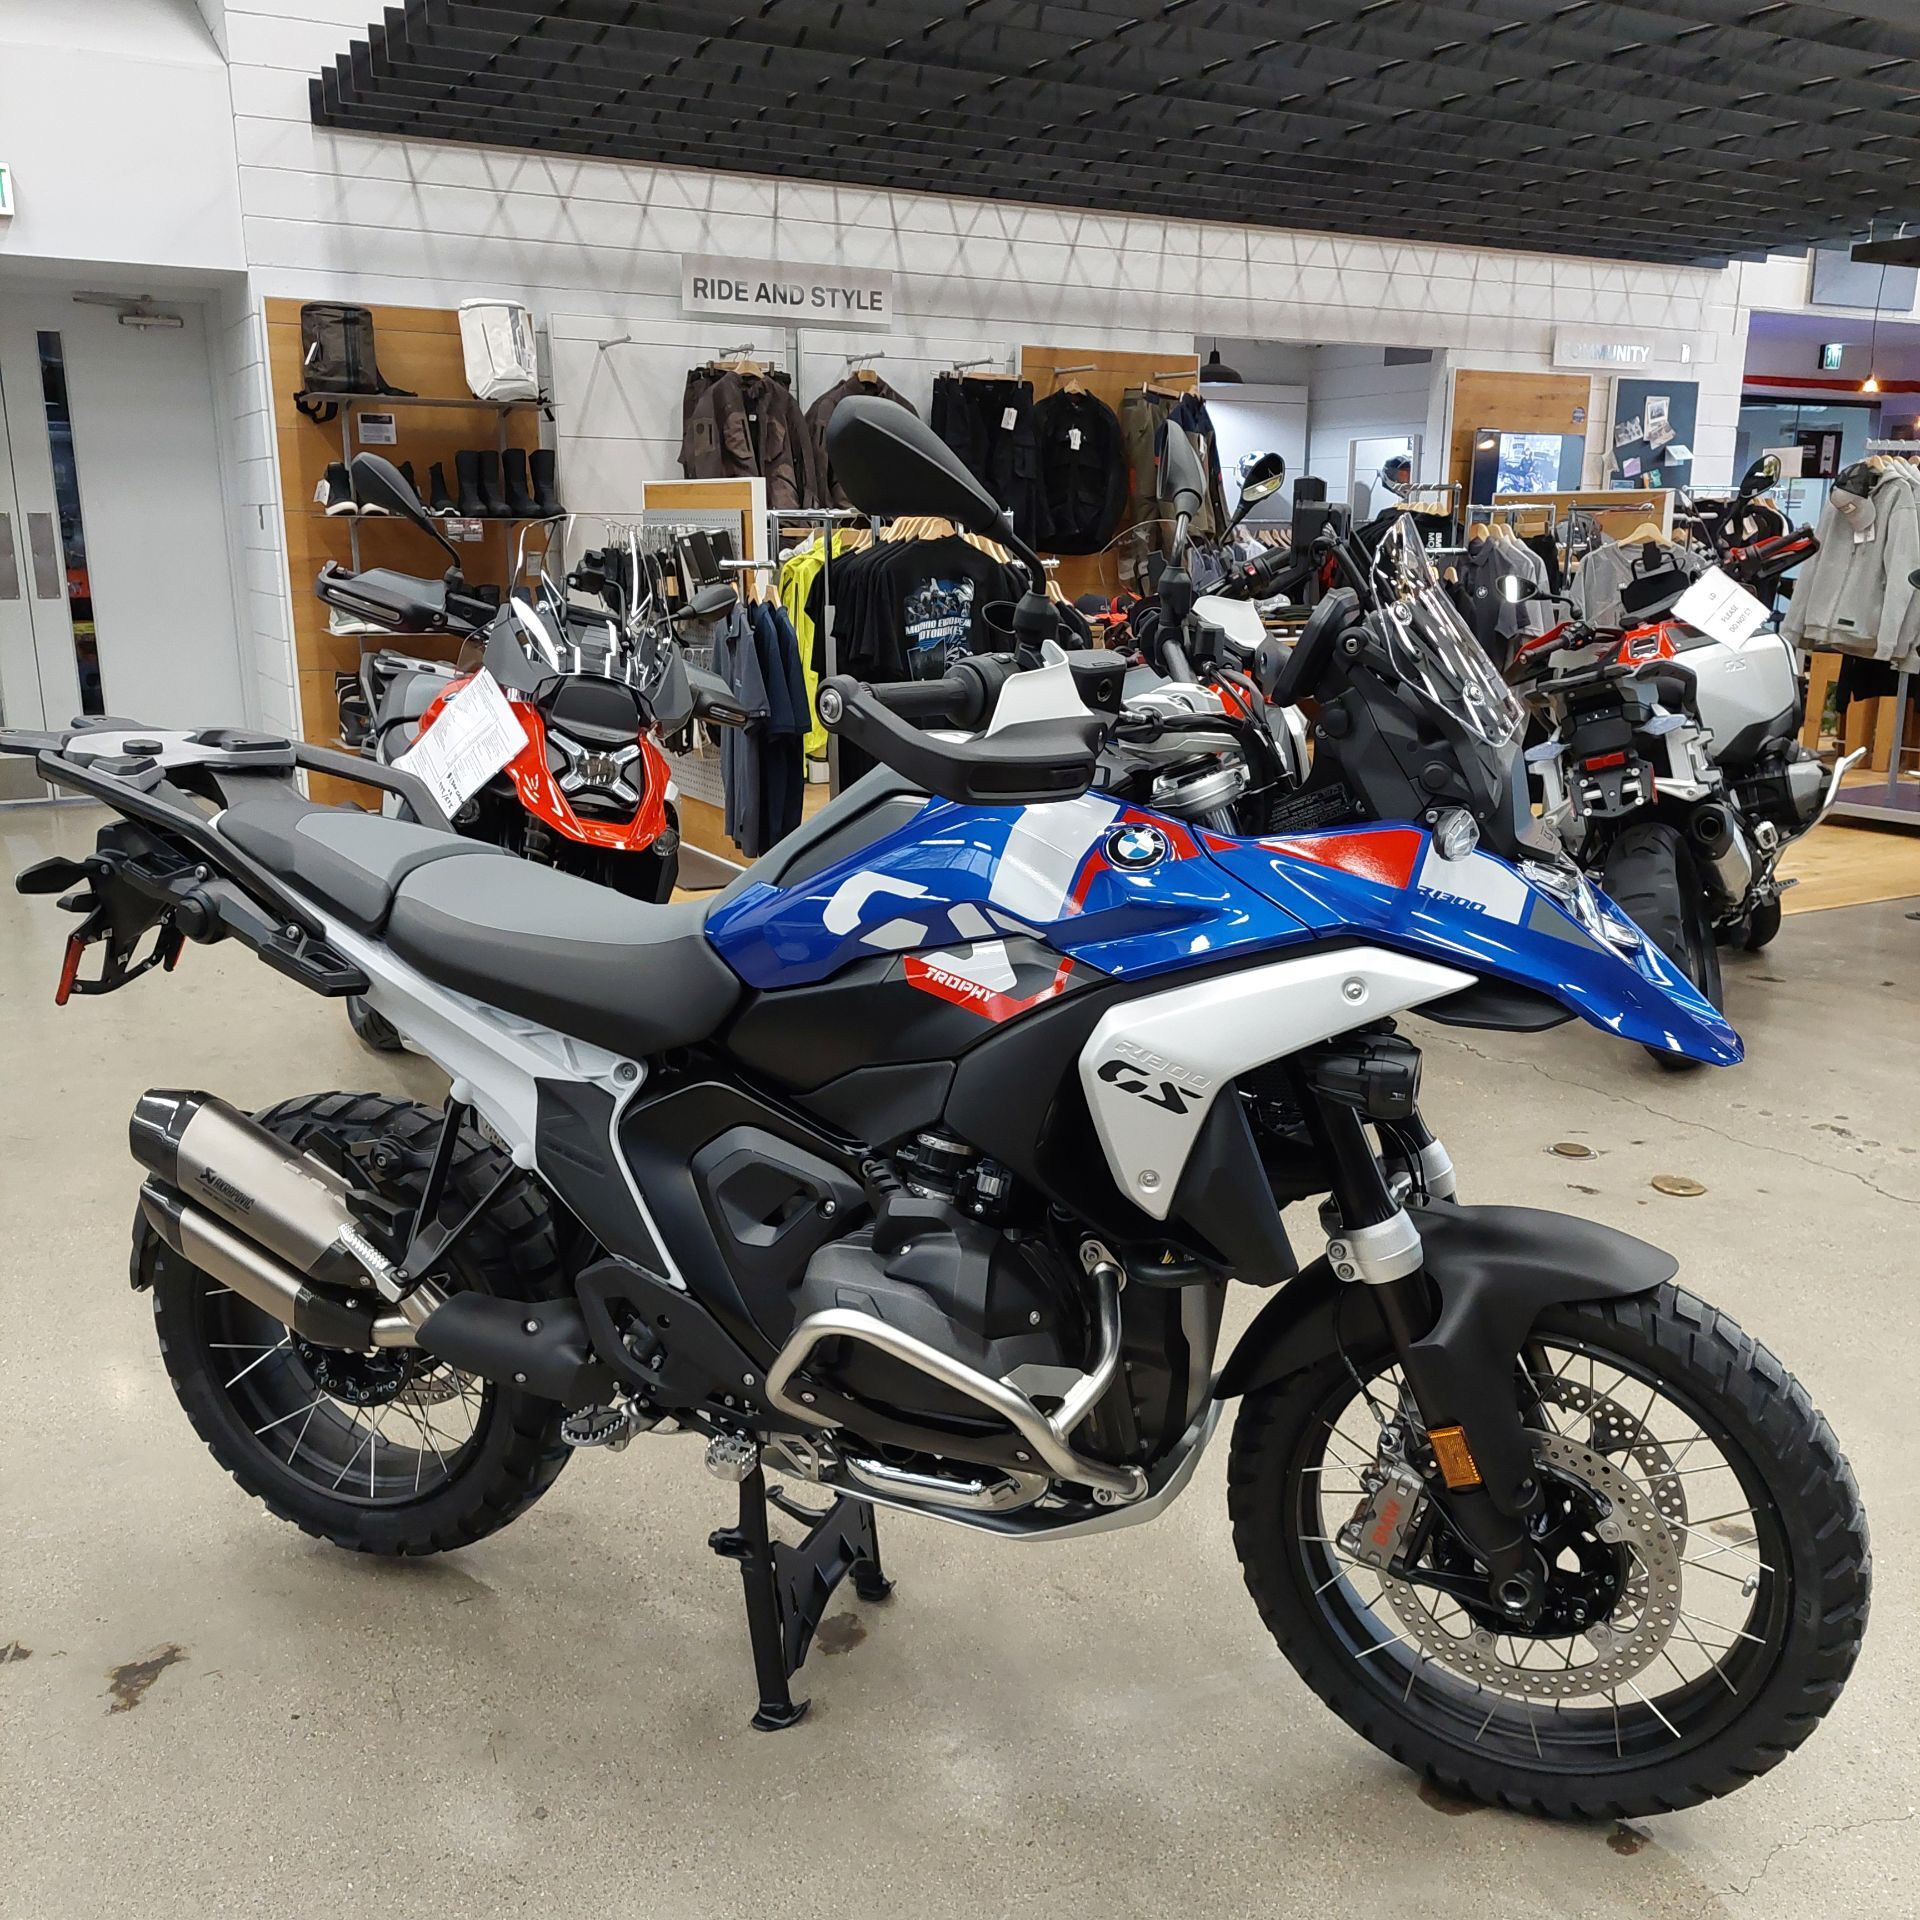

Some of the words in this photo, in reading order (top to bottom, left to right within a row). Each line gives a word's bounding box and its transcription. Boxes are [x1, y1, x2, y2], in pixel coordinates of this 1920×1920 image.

[692, 277, 749, 302] RIDE
[754, 282, 805, 305] AND
[811, 286, 883, 311] STYLE
[1418, 885, 1487, 914] R1300
[924, 966, 998, 1002] TROPHY
[1097, 1060, 1204, 1115] GS
[1373, 1499, 1401, 1546] BMW
